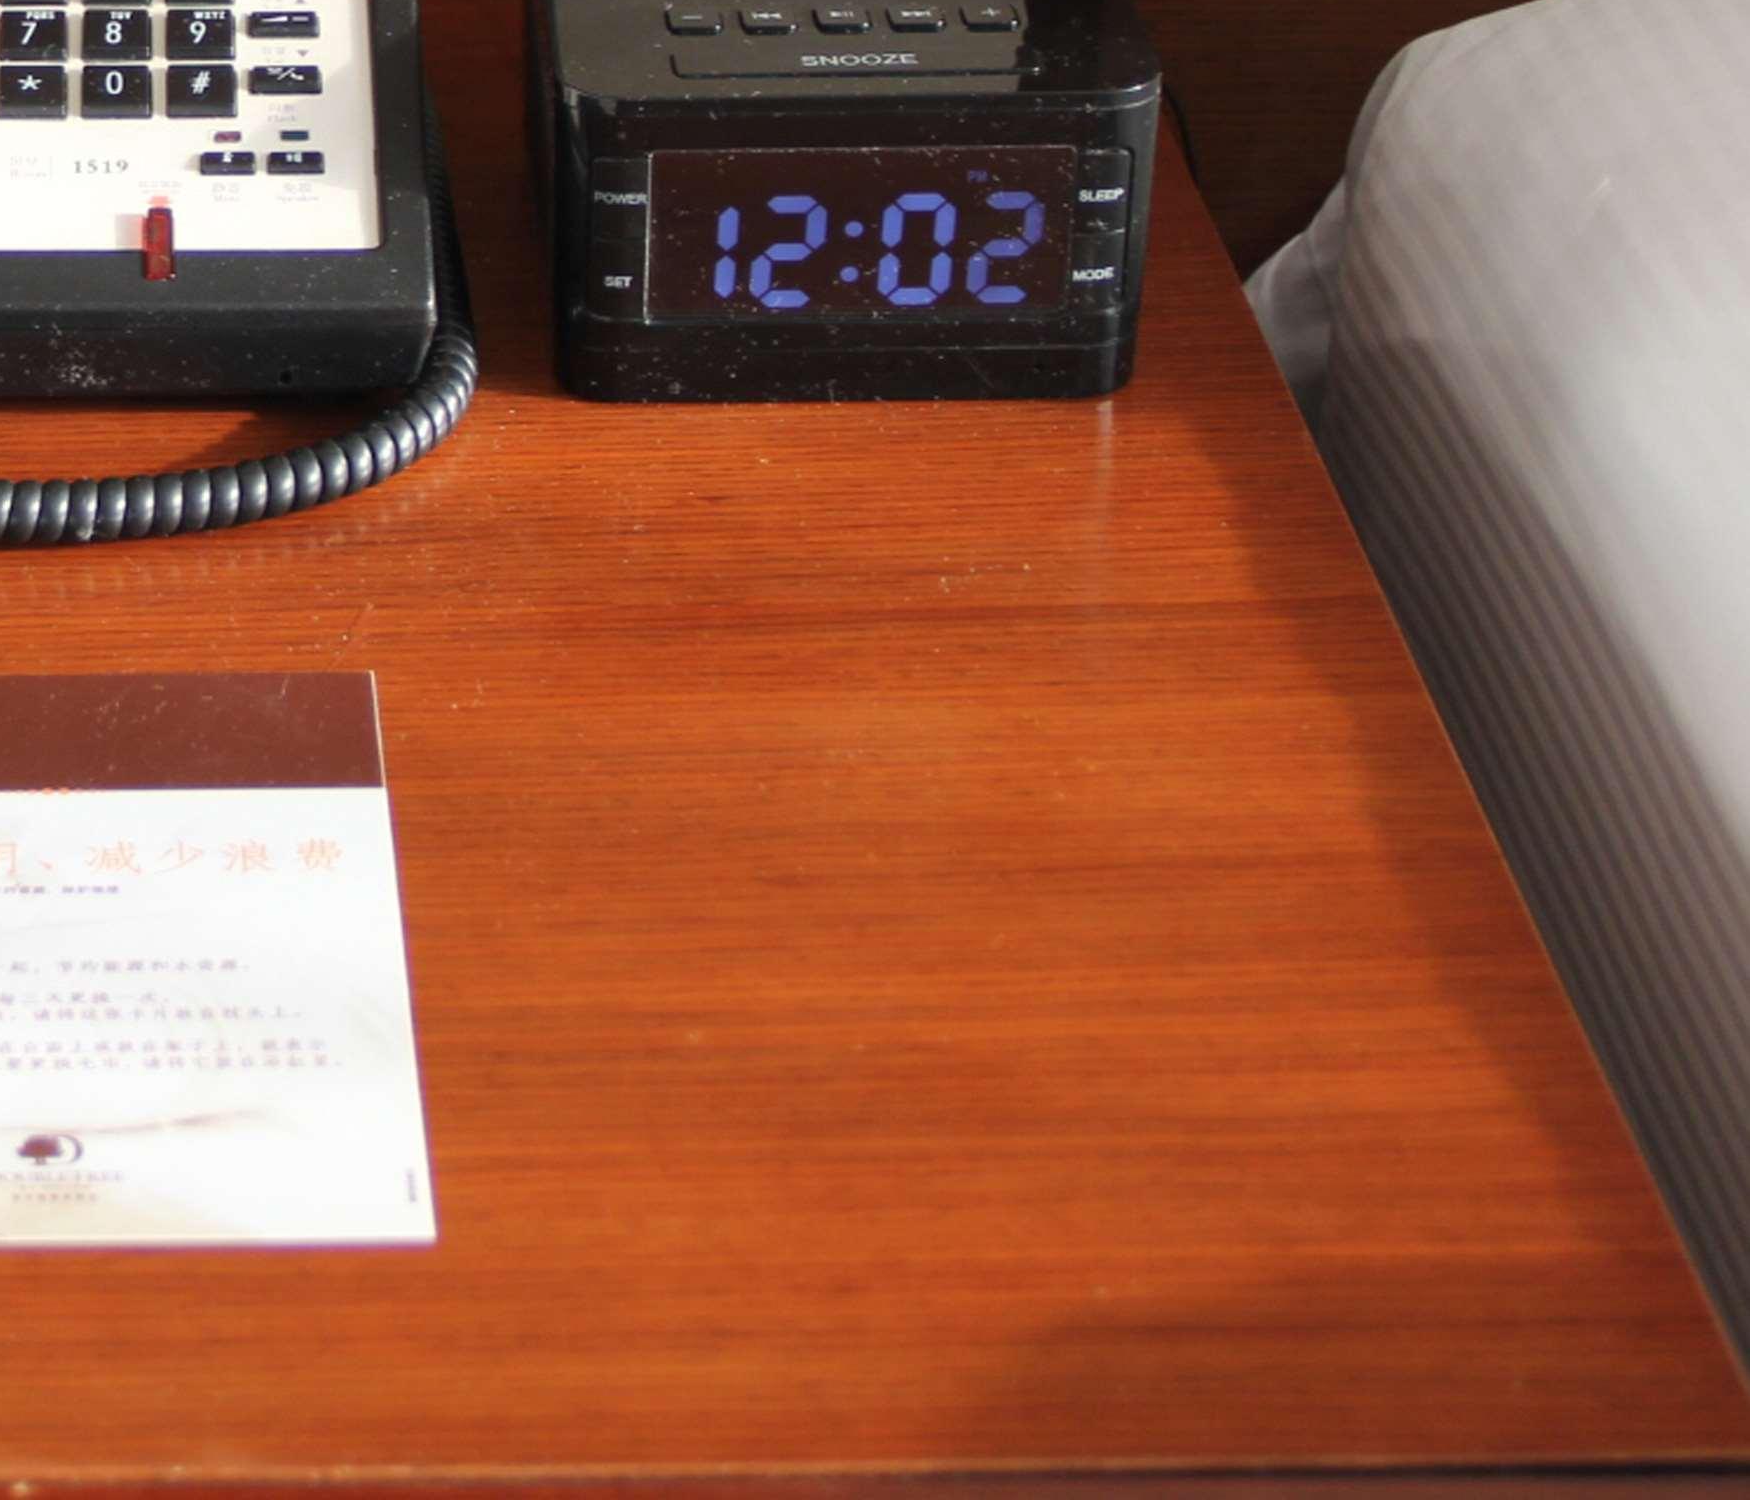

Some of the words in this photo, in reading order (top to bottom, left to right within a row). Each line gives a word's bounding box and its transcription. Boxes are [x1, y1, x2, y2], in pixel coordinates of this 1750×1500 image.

[193, 11, 226, 19] WXYZ
[21, 21, 38, 44] 7
[105, 21, 122, 44] 8
[189, 21, 206, 44] 9
[800, 53, 919, 67] SNOOZE
[105, 71, 123, 95] 0
[190, 70, 211, 94] #
[73, 159, 129, 174] 1519
[966, 169, 988, 183] PM
[594, 191, 649, 205] POWER
[1078, 187, 1125, 202] SLEEP
[712, 191, 1046, 309] 12:02
[1071, 266, 1115, 281] MODE
[603, 276, 633, 288] SET
